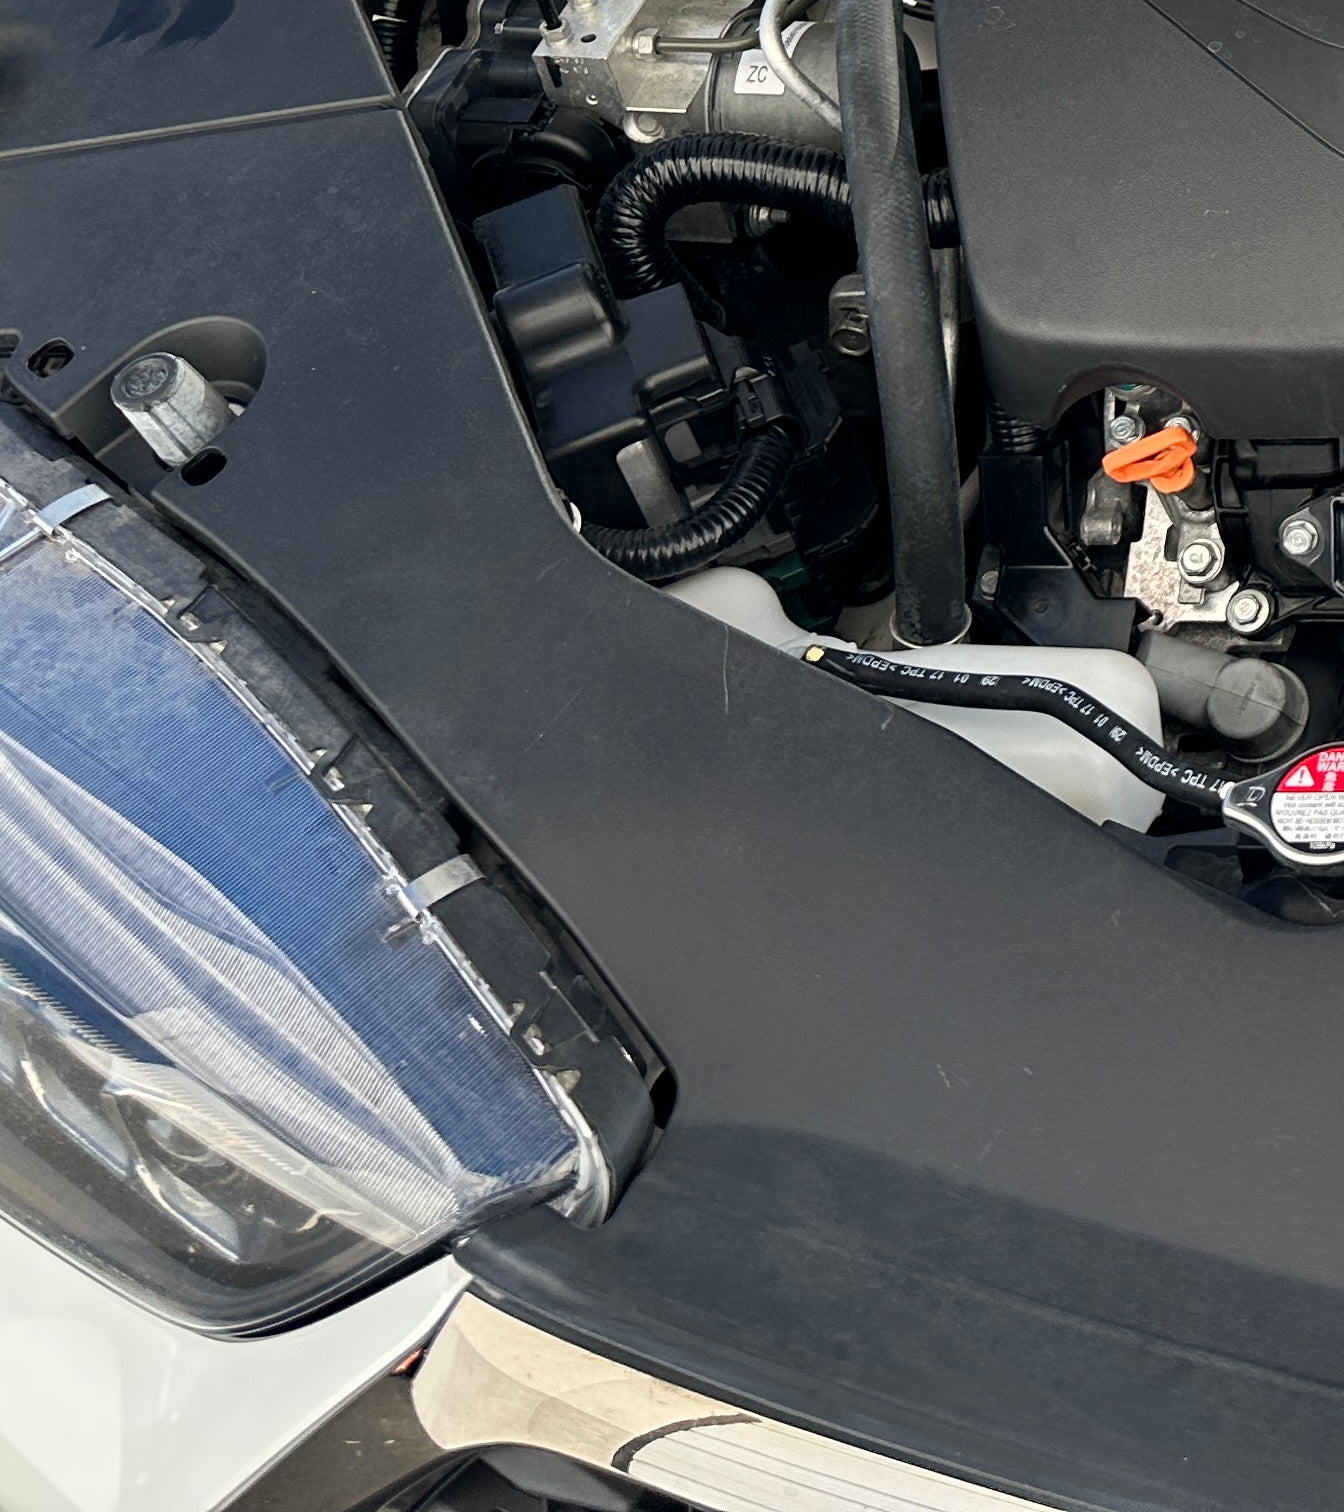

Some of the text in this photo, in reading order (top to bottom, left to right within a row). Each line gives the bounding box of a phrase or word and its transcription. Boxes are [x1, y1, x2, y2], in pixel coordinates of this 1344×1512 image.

[900, 665, 926, 678] TPC
[954, 673, 970, 685] 01
[1063, 690, 1085, 708] TPC
[1094, 713, 1109, 728] 01
[1134, 746, 1180, 779] >EPDM<
[1180, 768, 1207, 789] TPC
